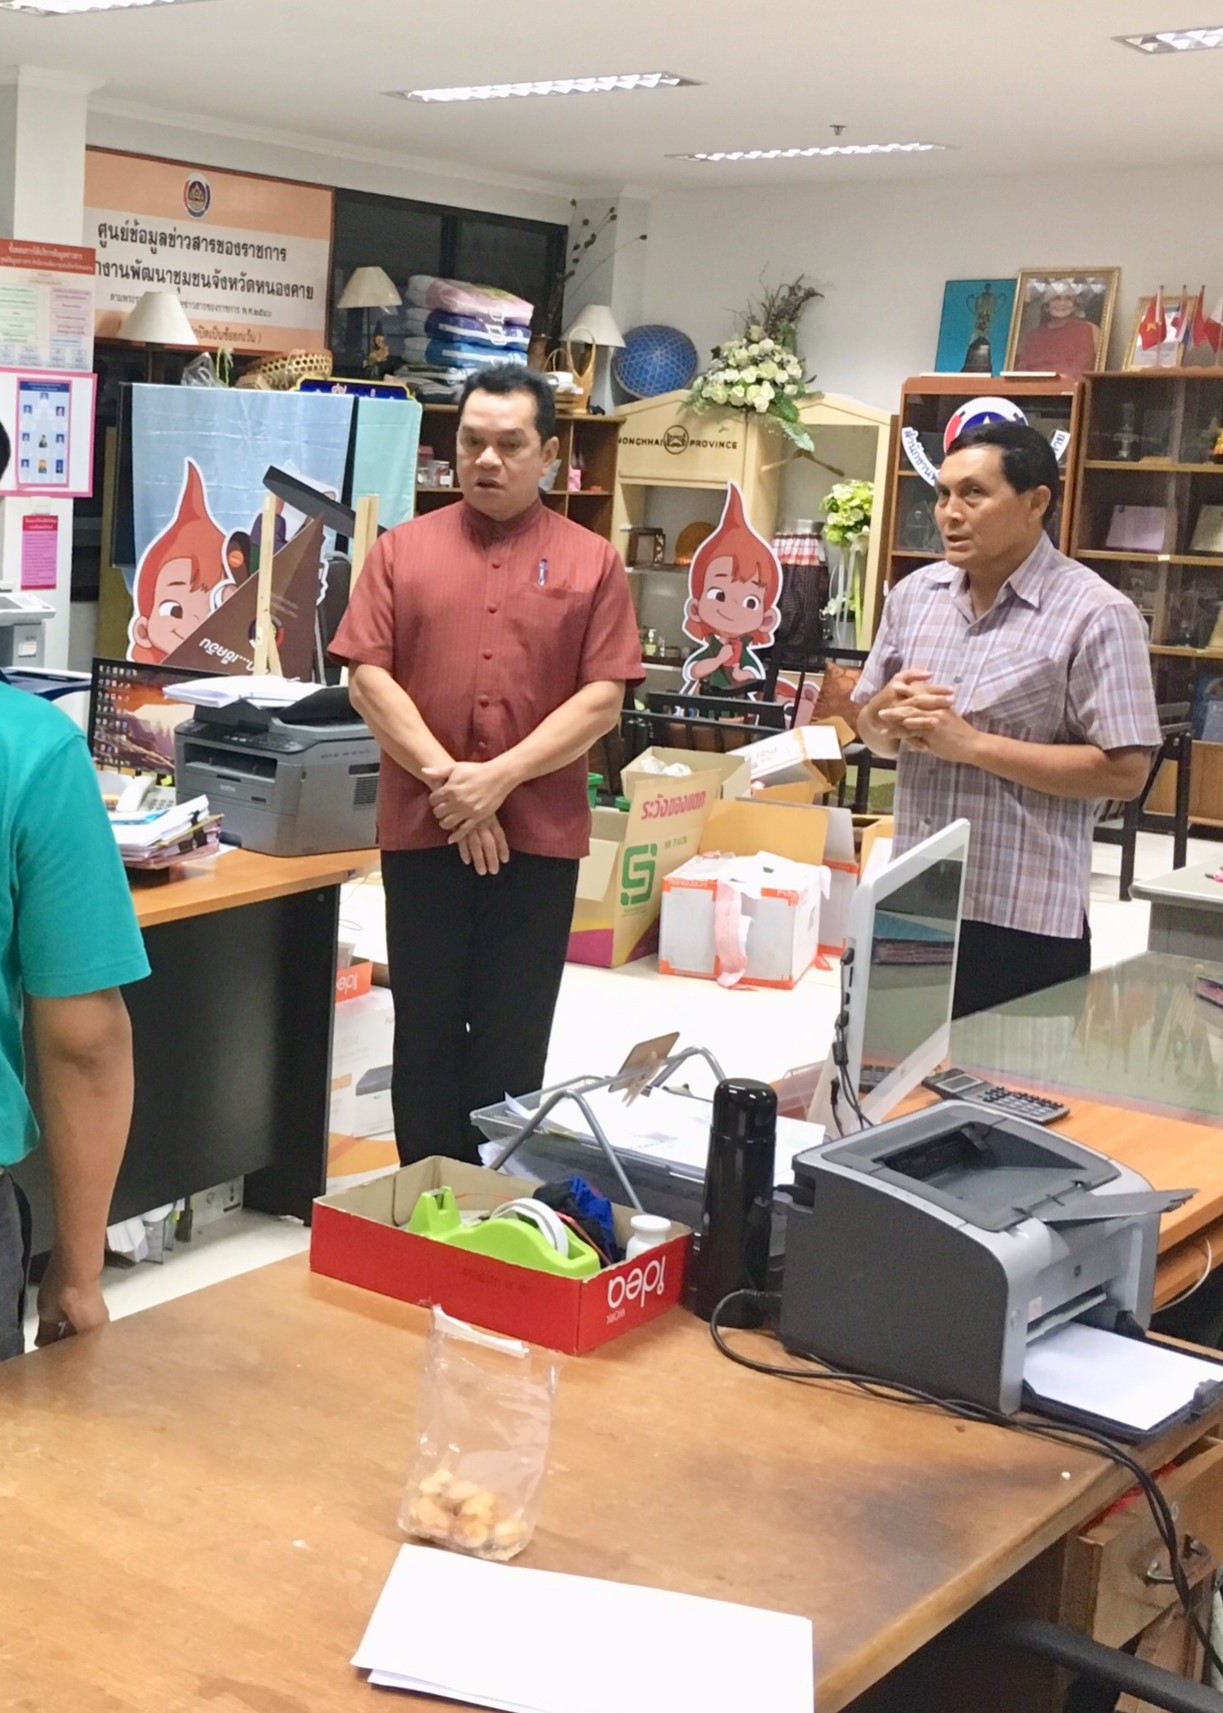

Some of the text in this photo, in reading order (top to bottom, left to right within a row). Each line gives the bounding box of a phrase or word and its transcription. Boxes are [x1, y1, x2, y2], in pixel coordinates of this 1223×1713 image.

[97, 219, 287, 262] ศูนย์ข้อมูลข่าวสารของราชการ
[689, 440, 738, 450] PROVINCE
[608, 1255, 666, 1309] idea
